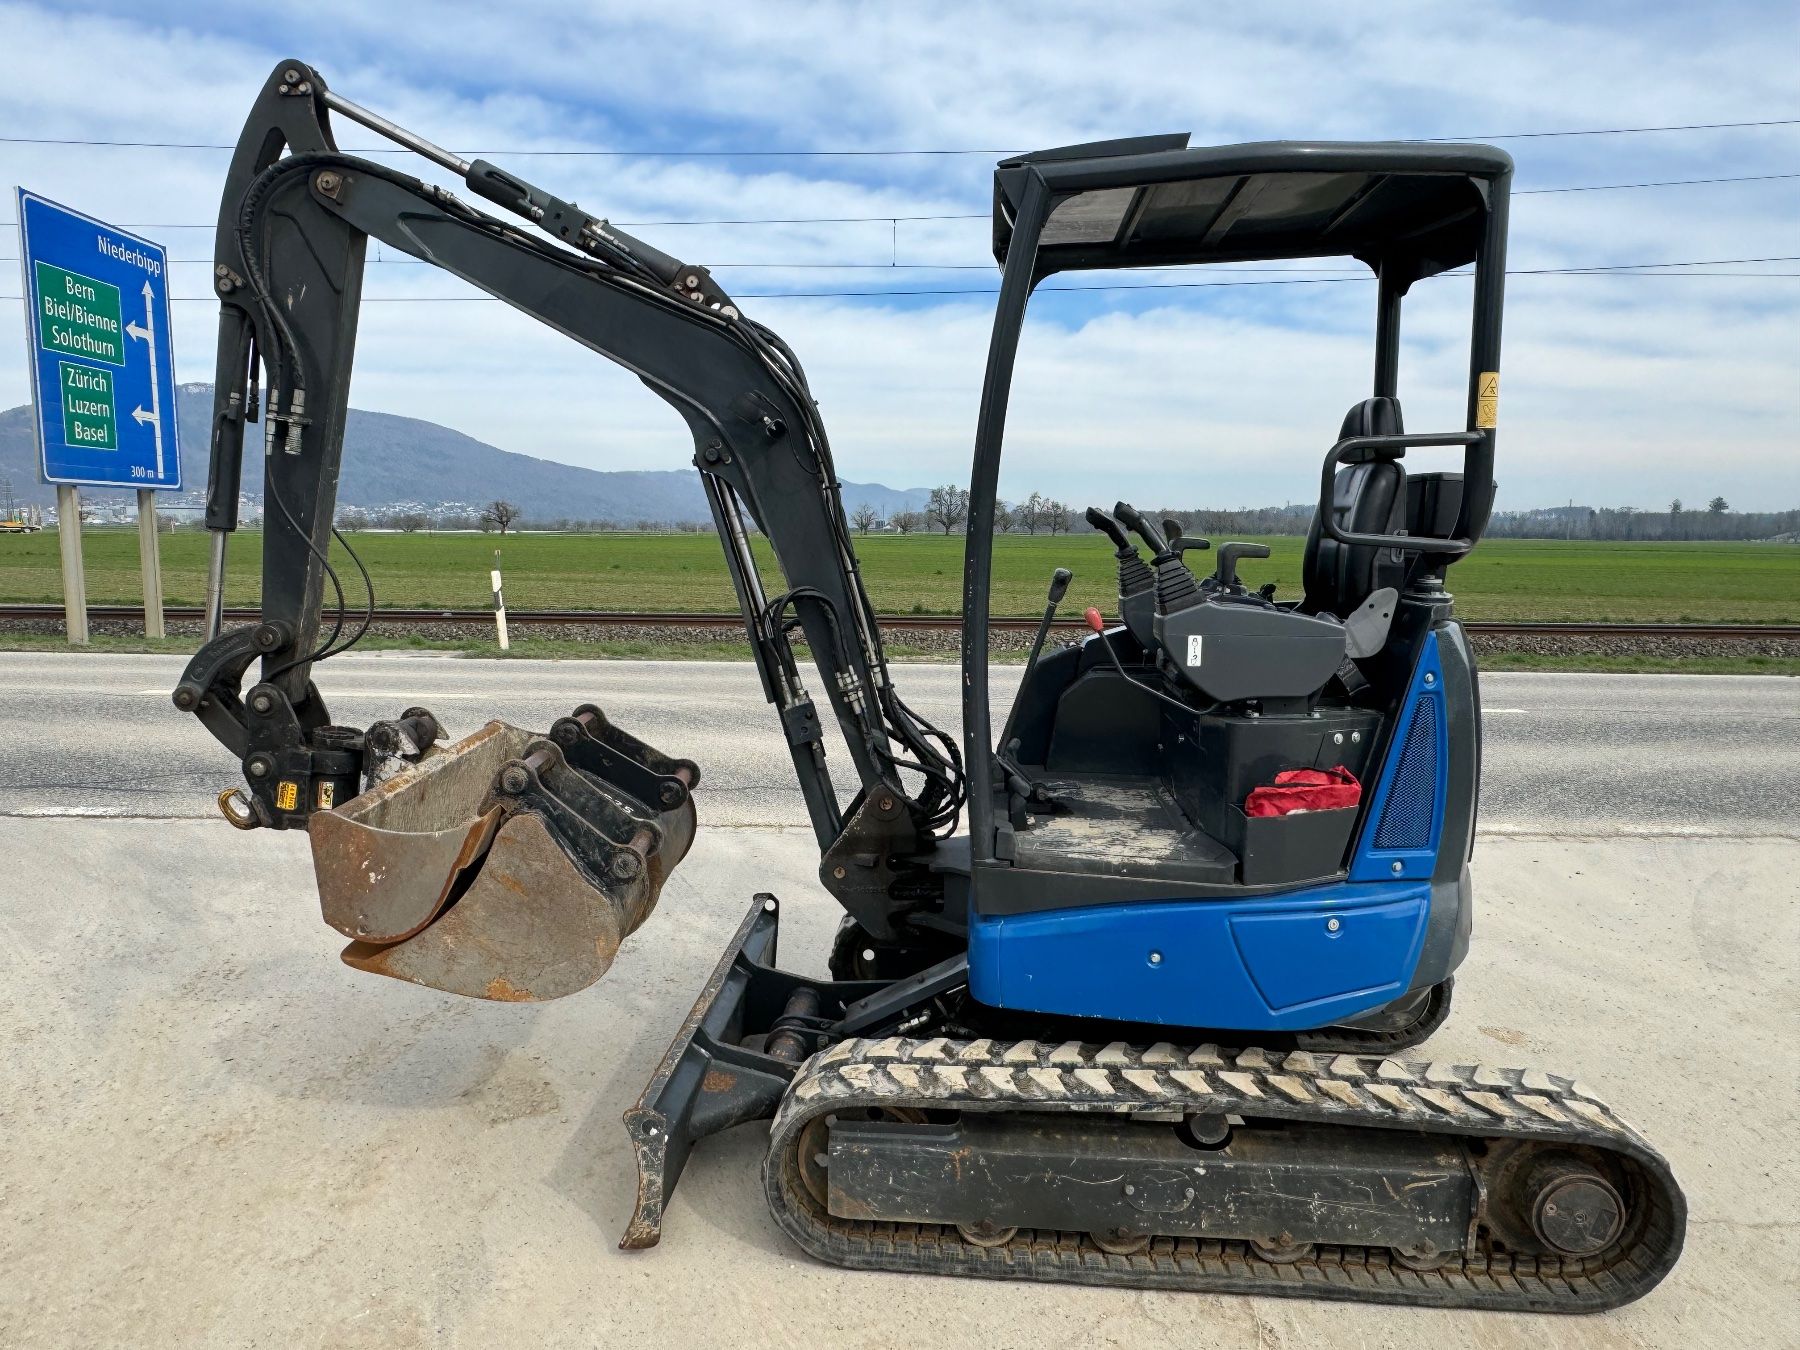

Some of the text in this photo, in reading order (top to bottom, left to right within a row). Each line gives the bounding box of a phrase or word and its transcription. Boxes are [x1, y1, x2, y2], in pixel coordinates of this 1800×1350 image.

[98, 235, 161, 277] Niederbipp
[65, 276, 95, 301] Bern
[44, 295, 118, 333] Biel/Bienne
[52, 325, 115, 357] Solothurn
[67, 368, 107, 392] Zürich
[69, 394, 110, 418] Luzern
[74, 421, 108, 443] Basel
[131, 466, 154, 478] 300 m
